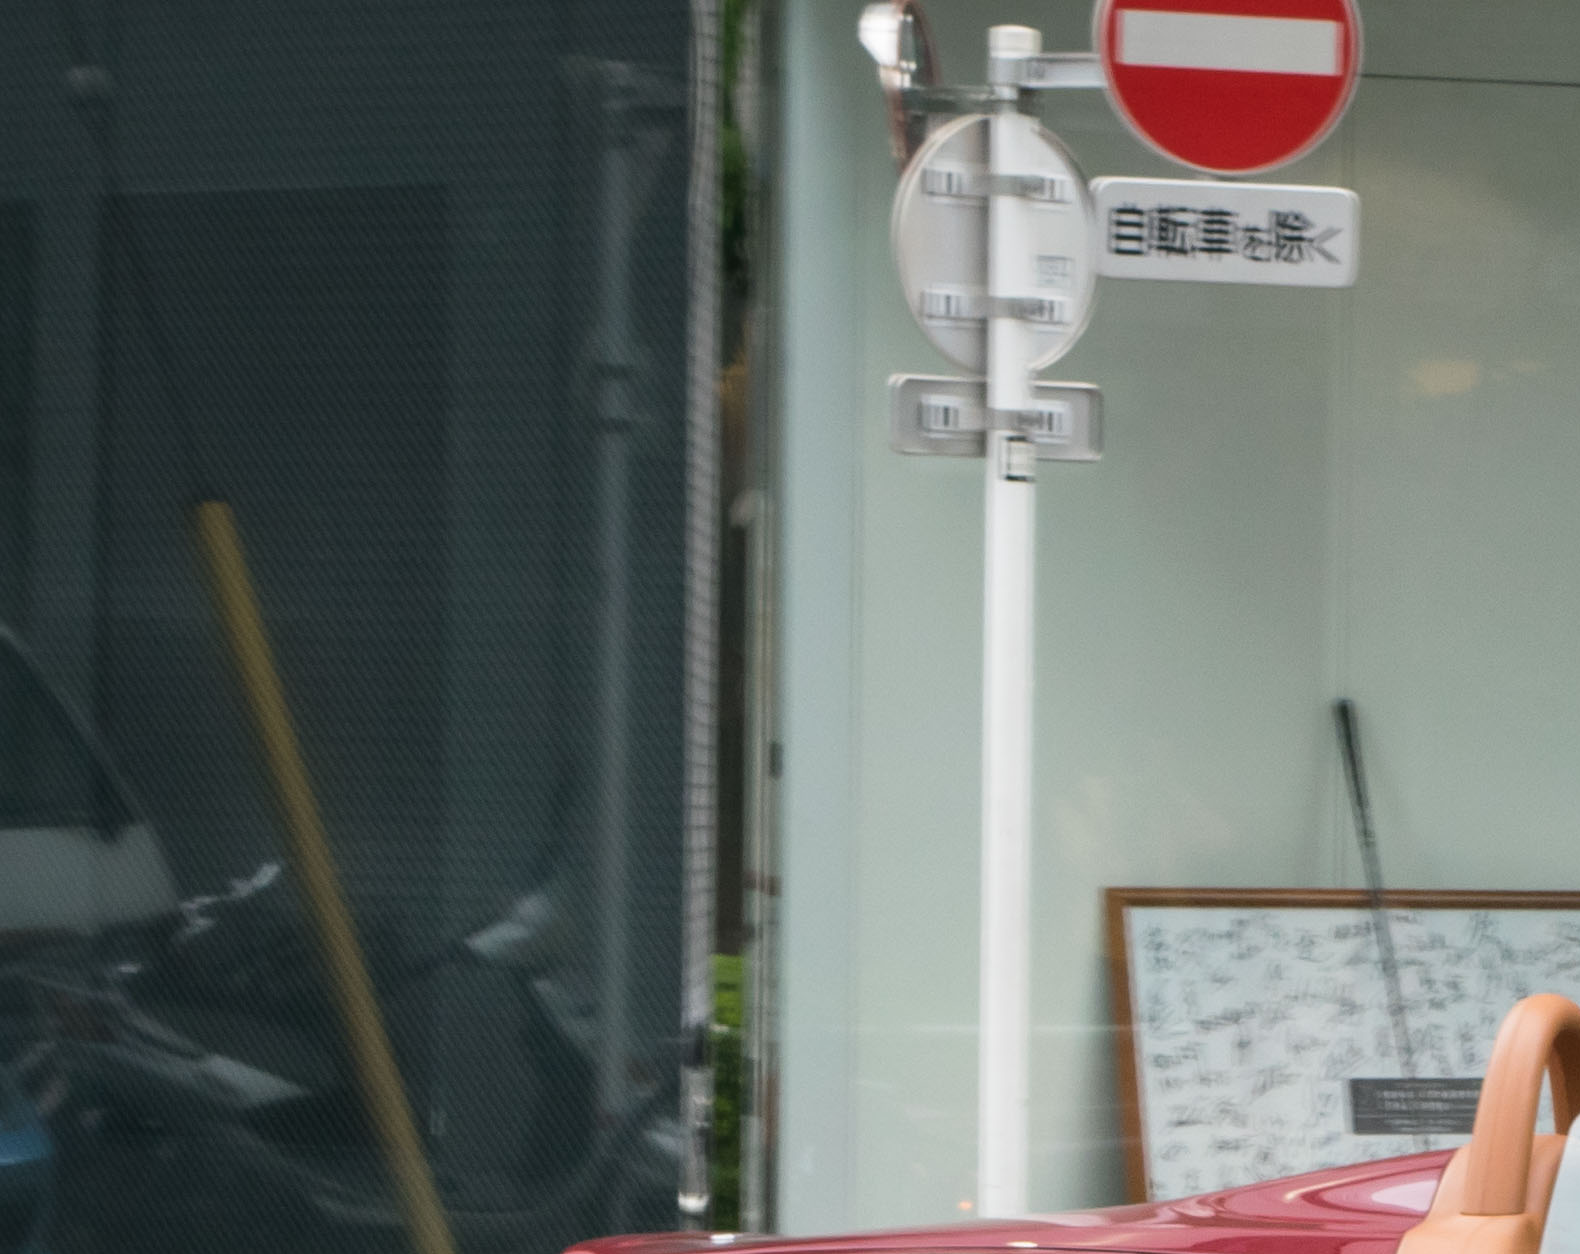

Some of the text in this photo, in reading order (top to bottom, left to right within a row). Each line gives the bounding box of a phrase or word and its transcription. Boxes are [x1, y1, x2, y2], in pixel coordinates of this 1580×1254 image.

[1108, 204, 1343, 264] 自転車を除く
